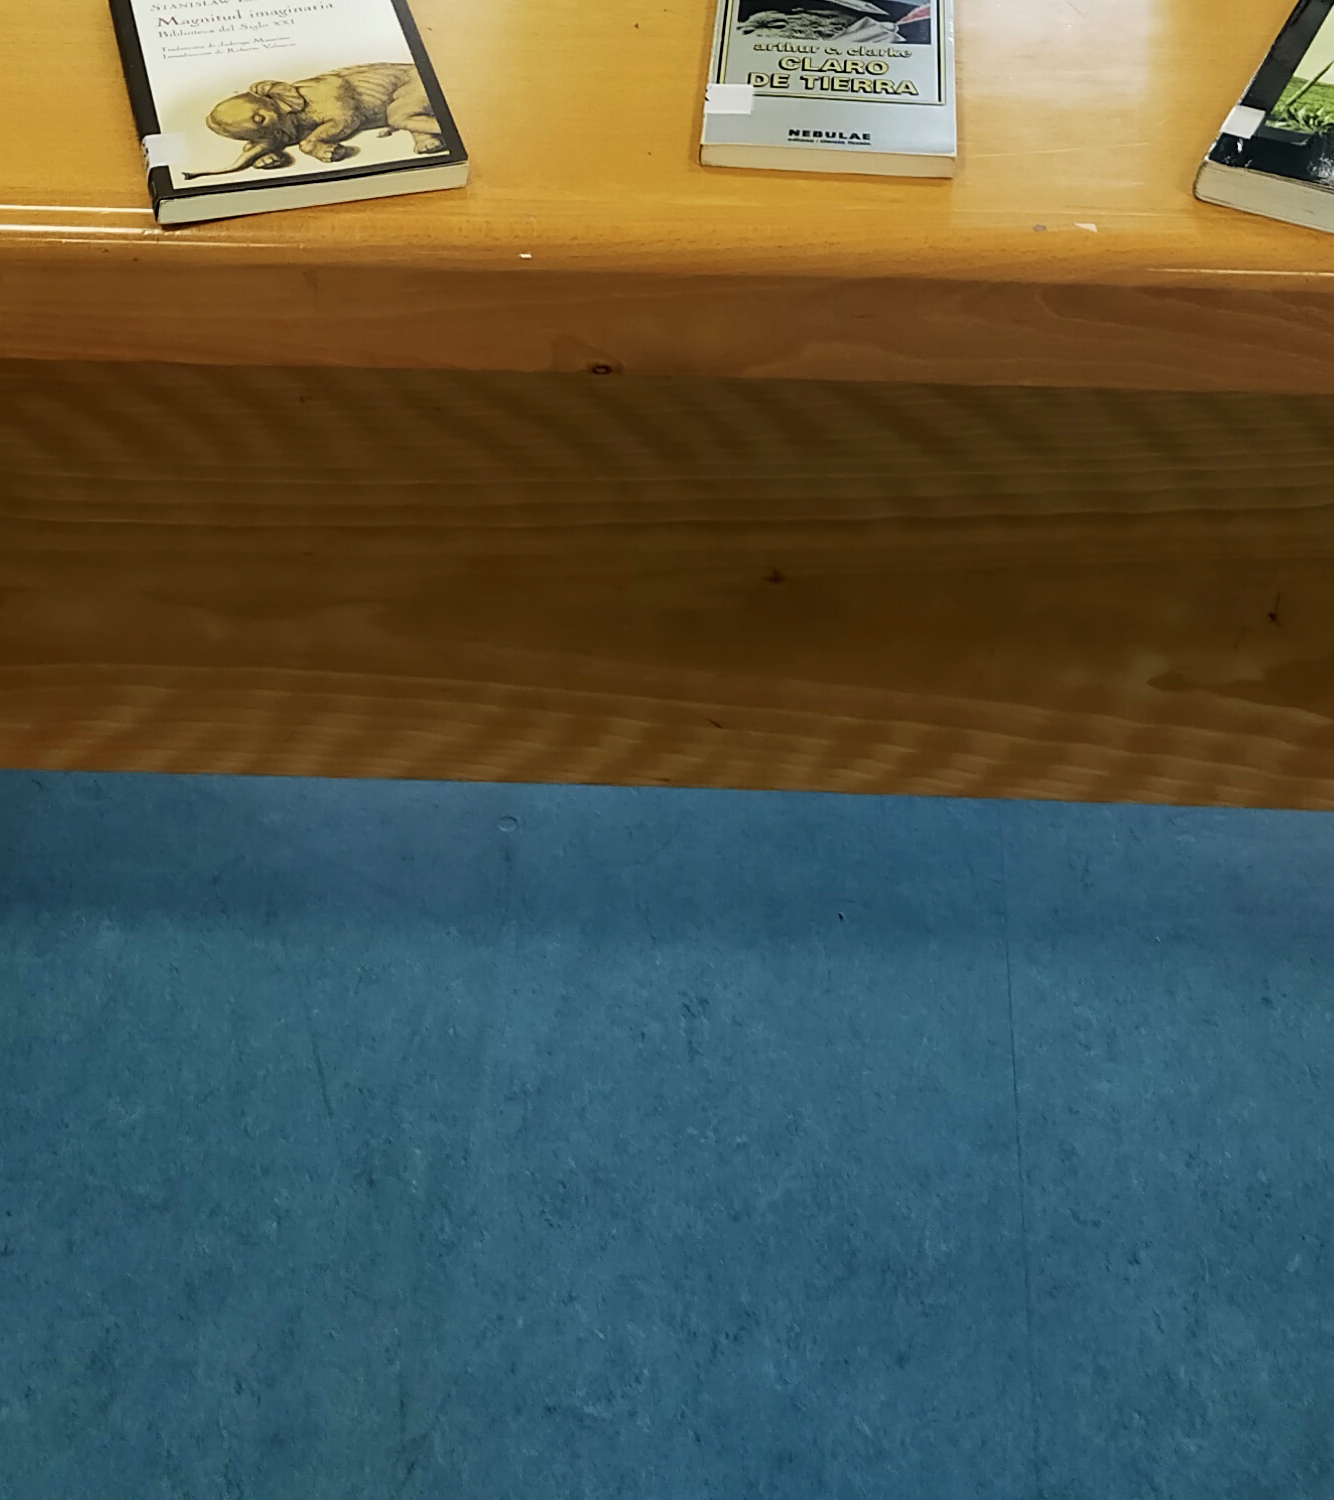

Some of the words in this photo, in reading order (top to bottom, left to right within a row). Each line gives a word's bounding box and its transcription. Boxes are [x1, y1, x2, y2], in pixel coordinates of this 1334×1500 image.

[155, 10, 243, 28] Magnitud
[250, 1, 334, 20] imaginaria
[753, 42, 820, 54] arthur
[846, 46, 913, 58] clarke
[779, 56, 889, 75] CLARO
[747, 72, 791, 88] DE
[799, 74, 919, 96] TIERRA
[788, 129, 871, 141] NEBULAE
